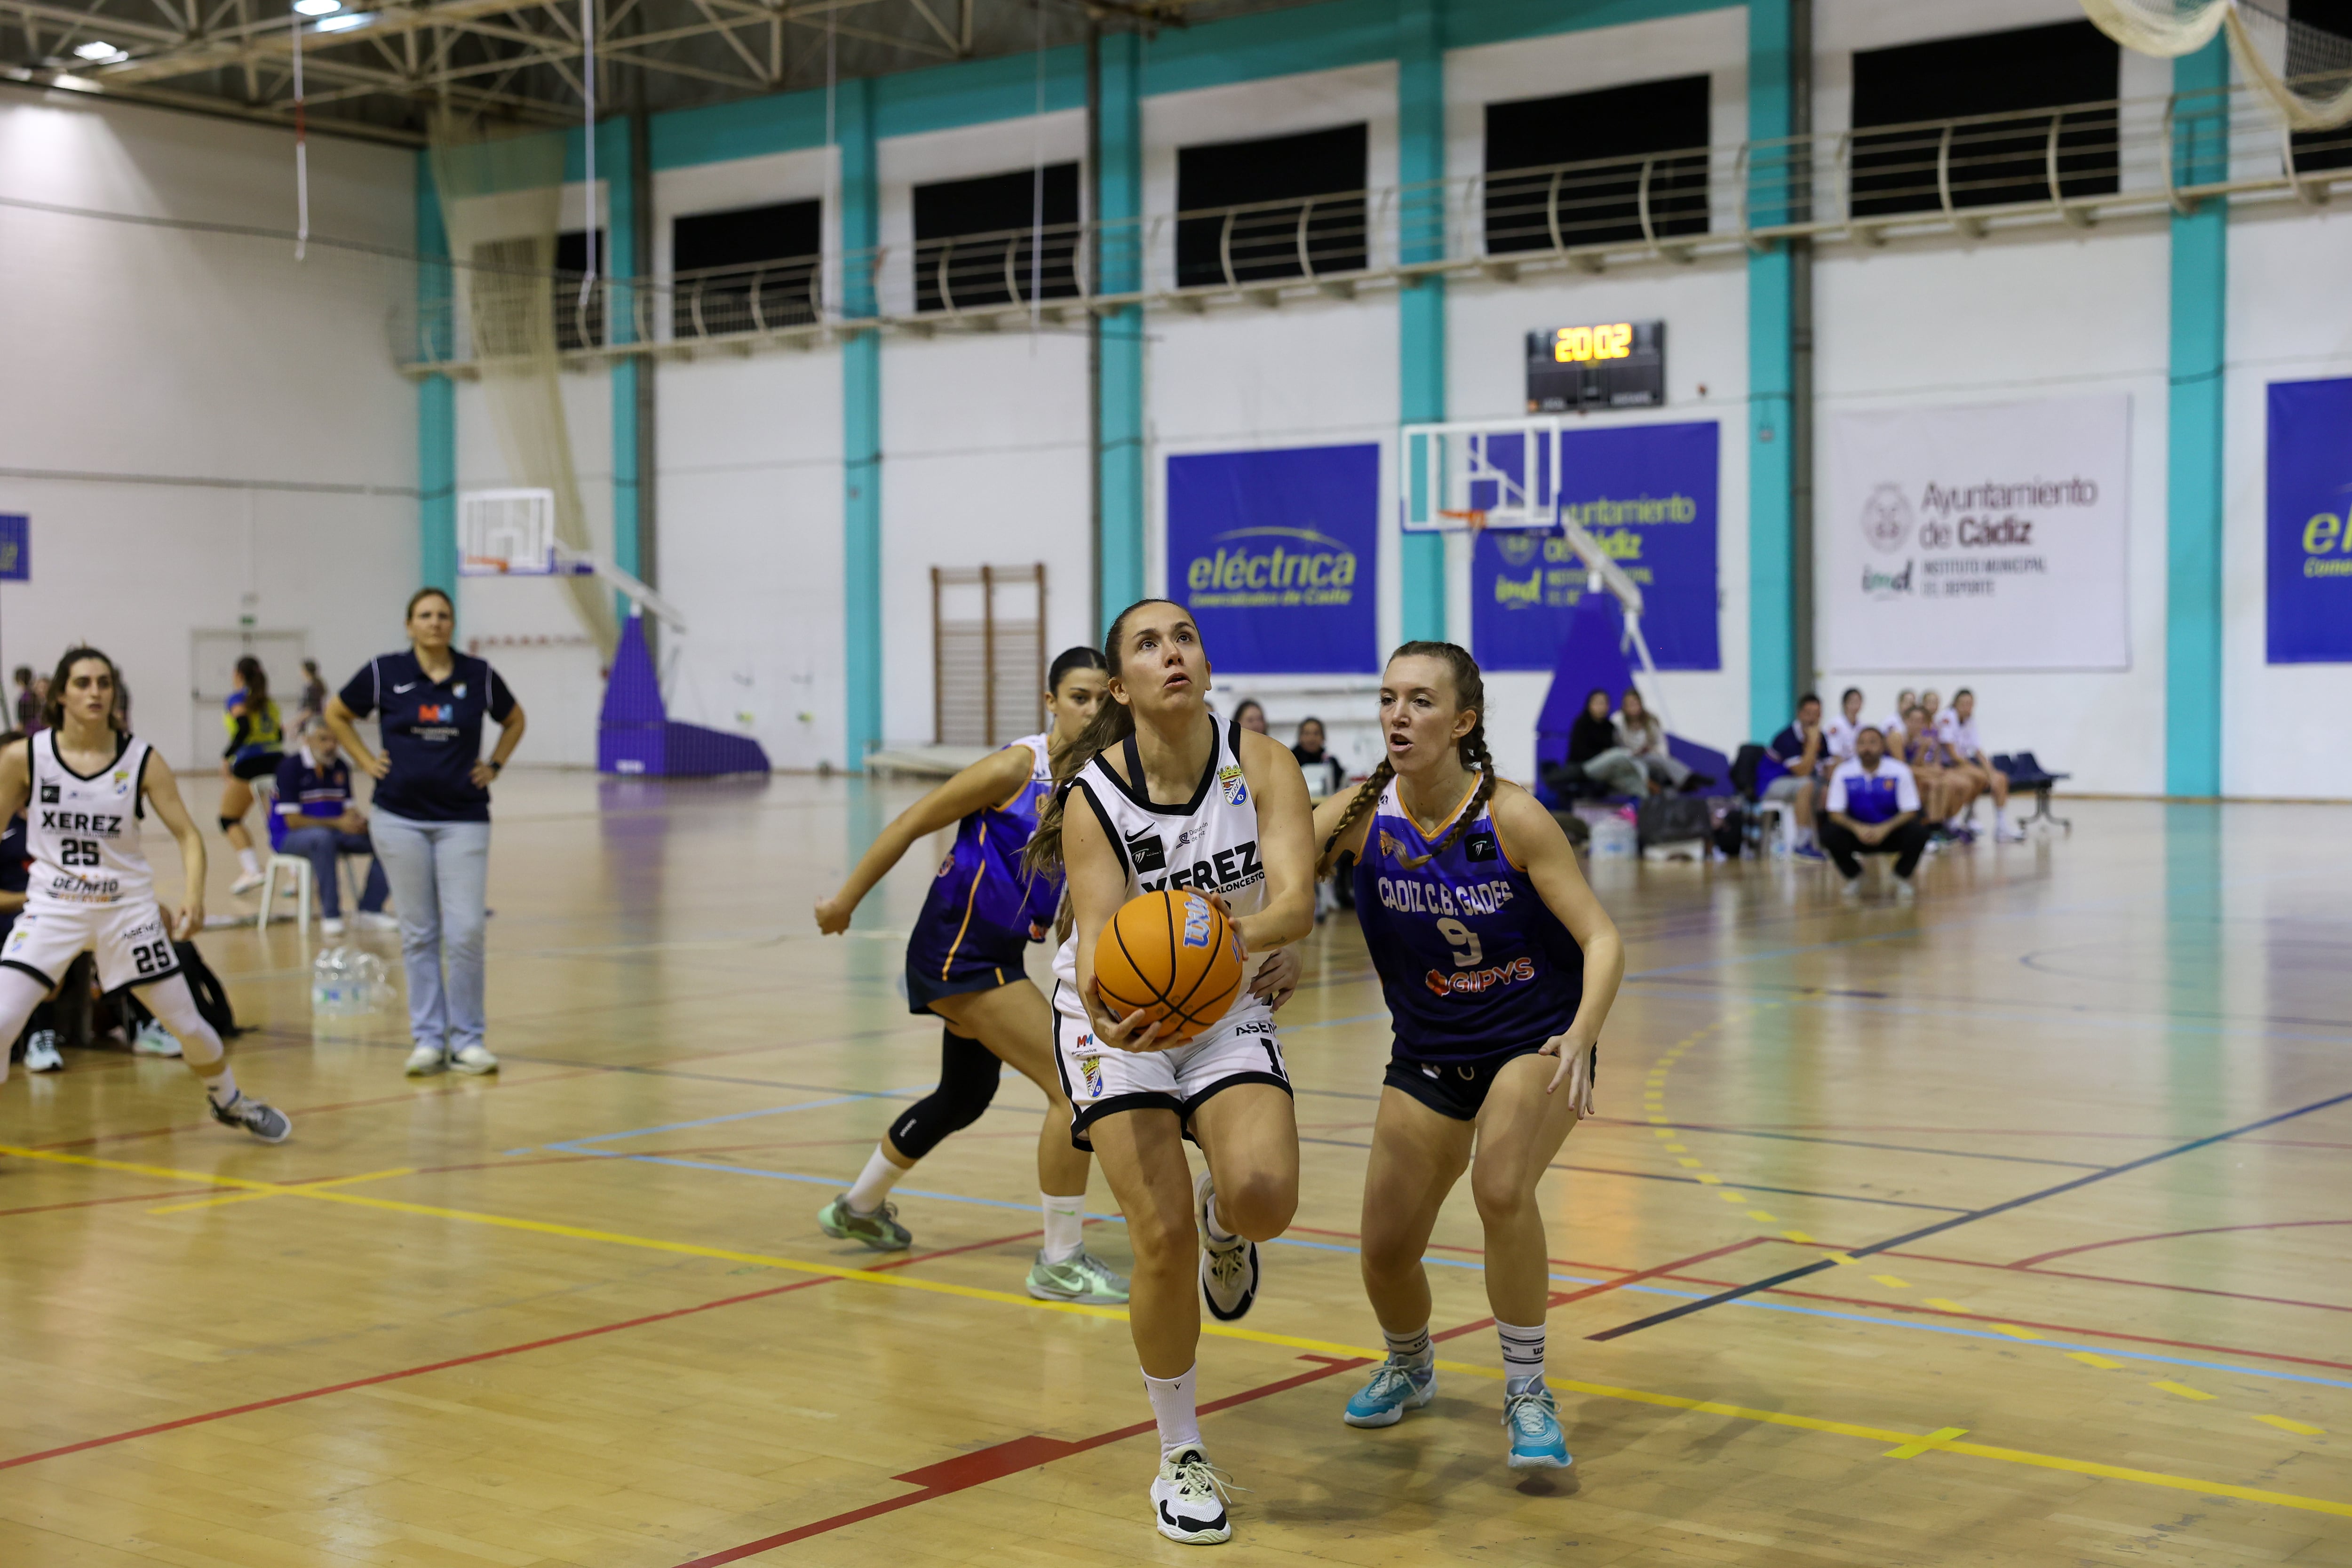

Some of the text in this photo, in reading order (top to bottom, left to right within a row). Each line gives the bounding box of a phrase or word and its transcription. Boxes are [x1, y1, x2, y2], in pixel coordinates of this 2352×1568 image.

[1920, 476, 2100, 514] Ayuntamiento
[1919, 514, 2034, 550] de Cádiz
[1188, 546, 1356, 590] eléctrica
[1229, 776, 1242, 801] XEREZ
[42, 811, 122, 832] XEREZ
[61, 838, 100, 866] 25
[1378, 876, 1514, 916] CADIZ C.B. GADES
[132, 940, 170, 973] 25
[1437, 917, 1483, 967] 9
[1449, 957, 1534, 993] GIPYS
